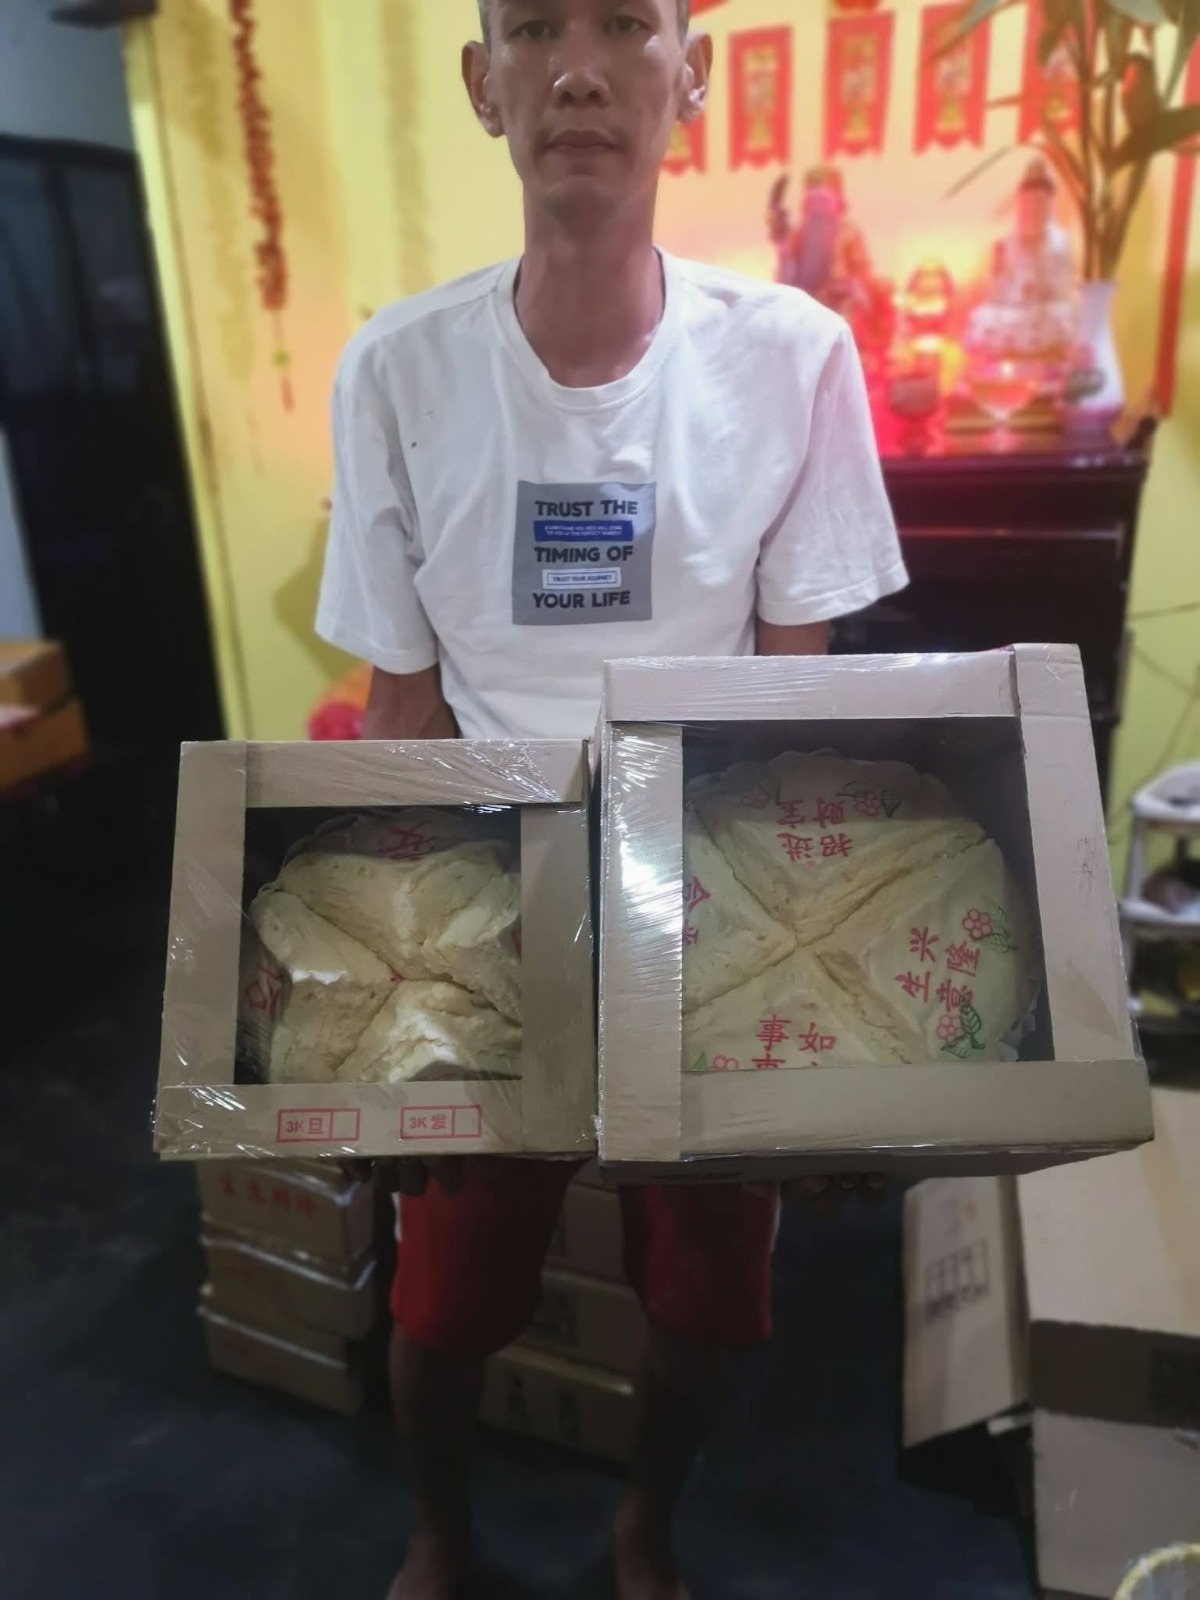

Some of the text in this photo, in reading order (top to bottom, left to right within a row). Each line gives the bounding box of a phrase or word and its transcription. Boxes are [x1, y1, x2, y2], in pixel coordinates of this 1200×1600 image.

[534, 500, 638, 517] TRUST THE
[534, 545, 634, 563] TIMING OF
[532, 591, 630, 608] YOUR LIFE
